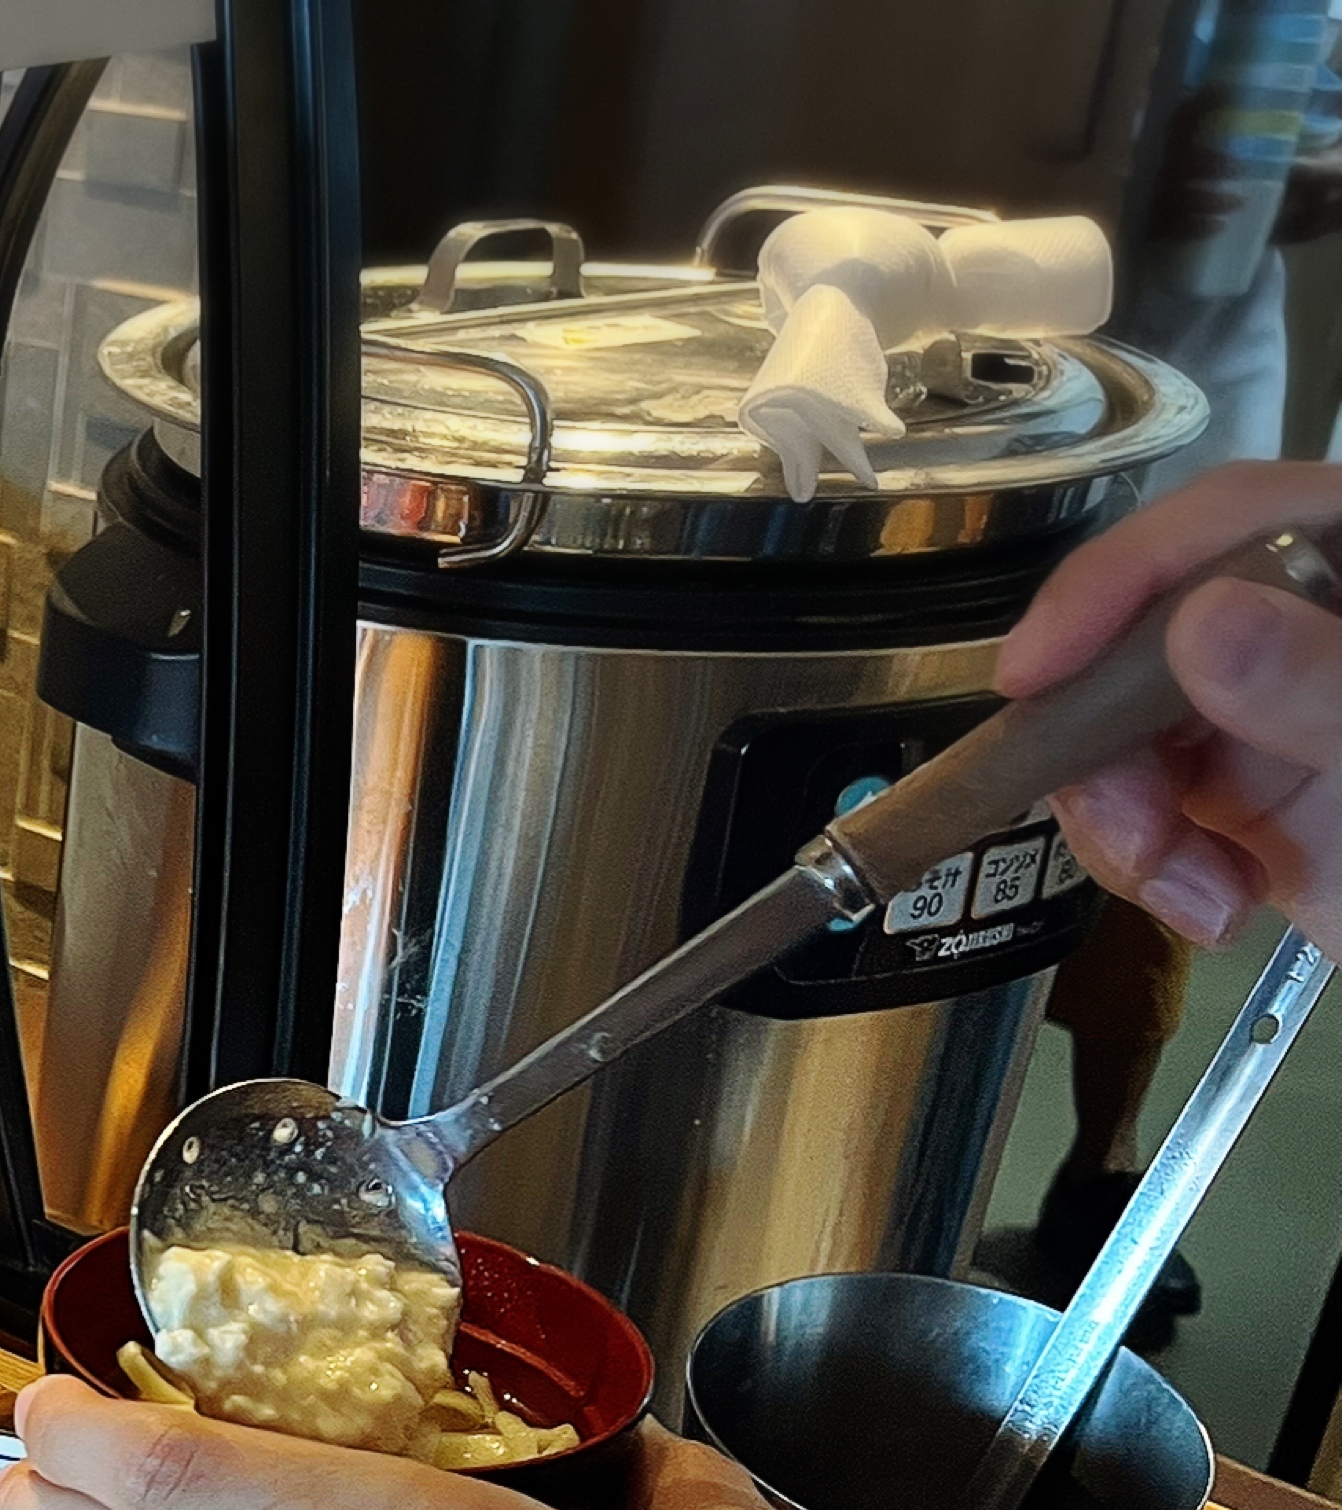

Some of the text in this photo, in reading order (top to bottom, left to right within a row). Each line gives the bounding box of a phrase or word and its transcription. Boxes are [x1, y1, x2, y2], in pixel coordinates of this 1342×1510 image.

[917, 866, 963, 890] そ汁
[993, 876, 1022, 904] 85
[910, 892, 943, 919] 90
